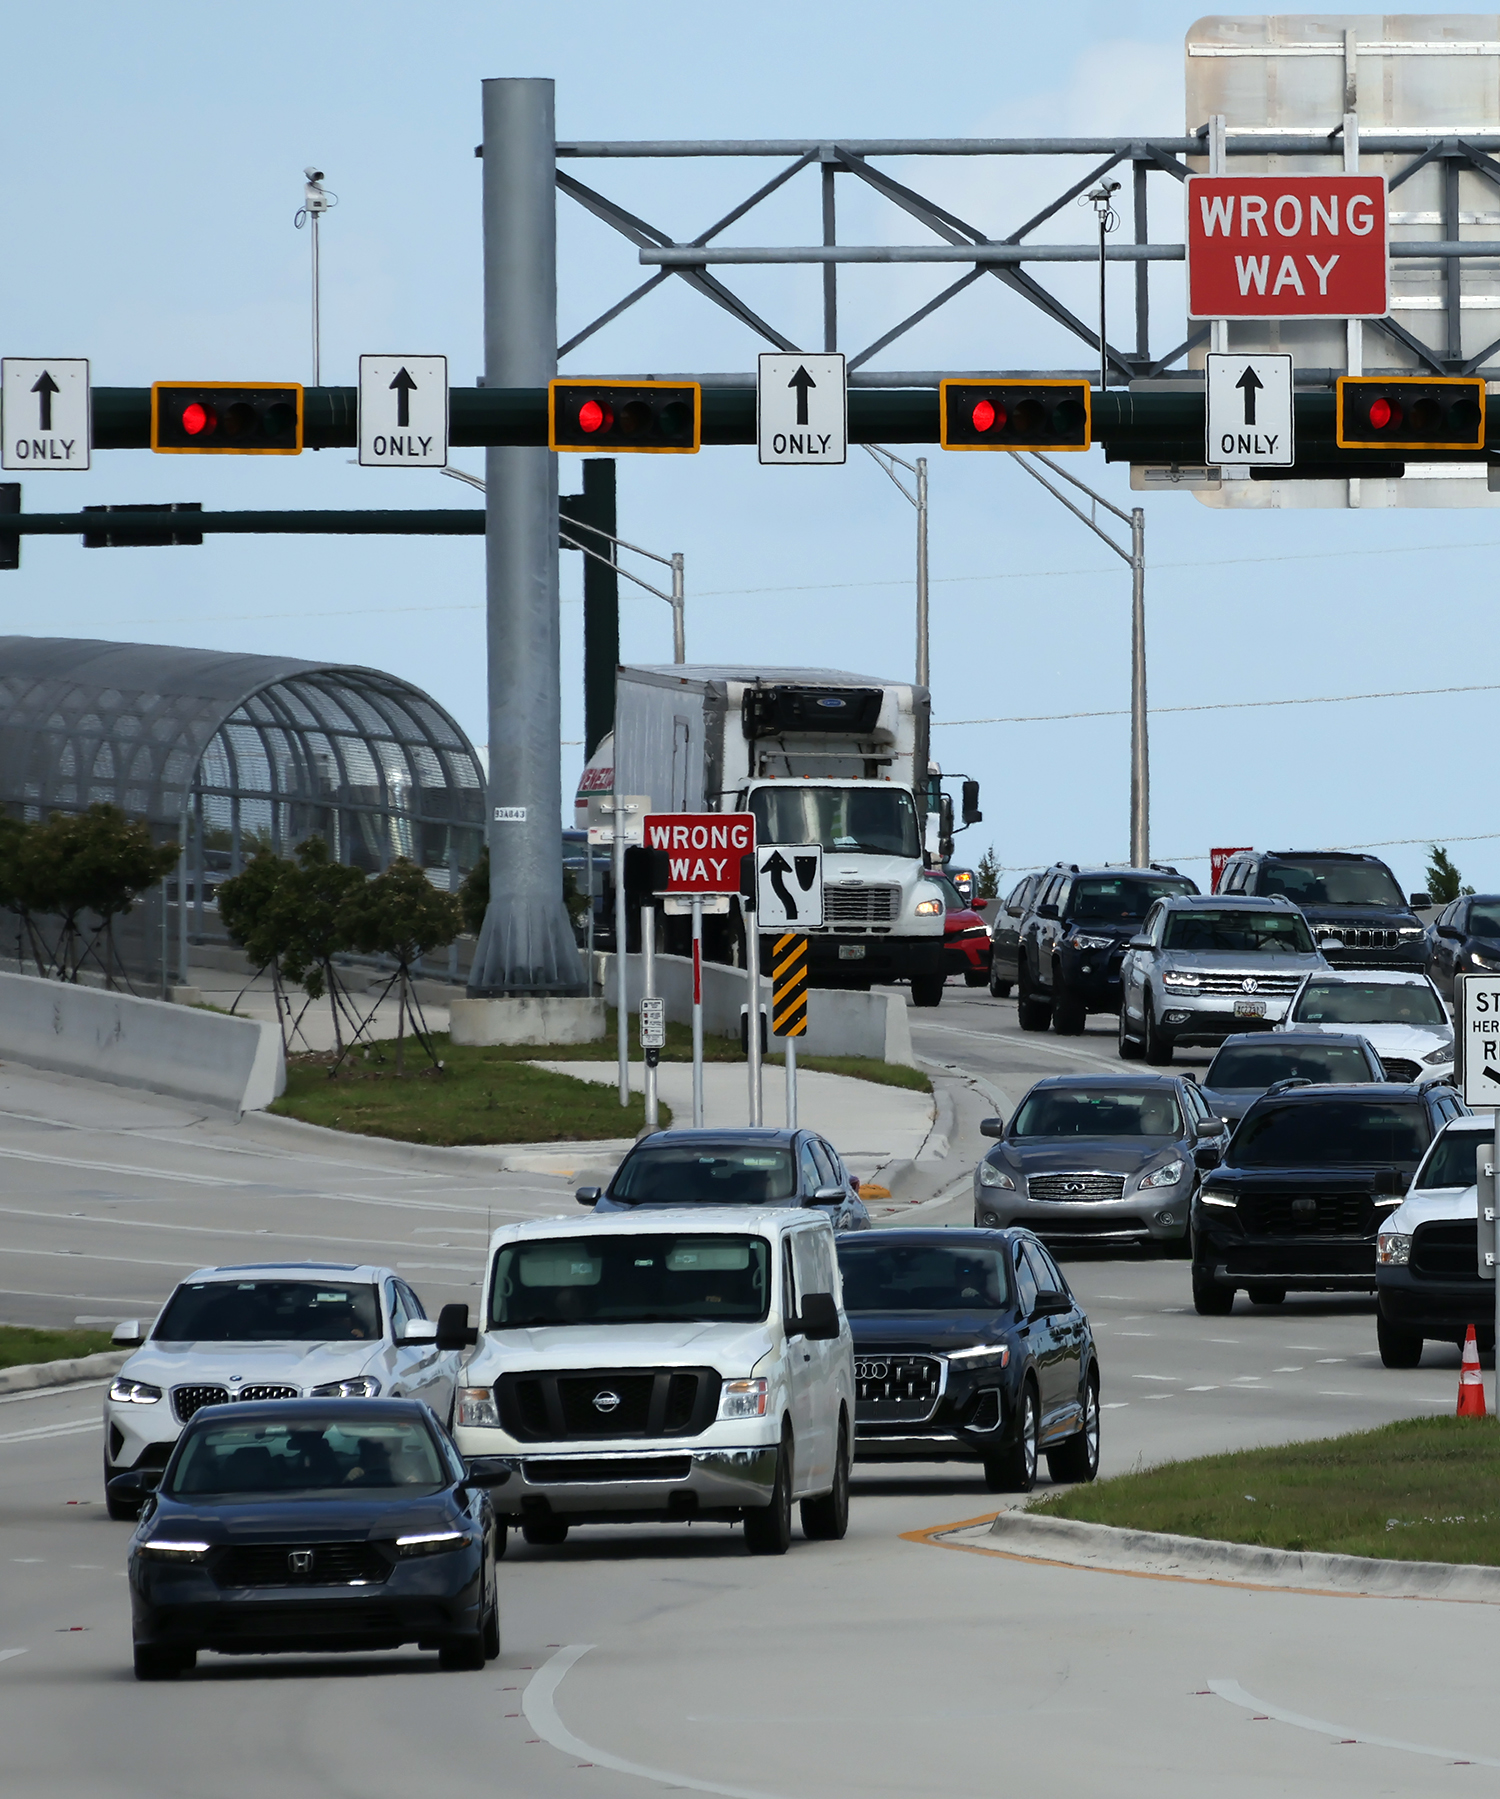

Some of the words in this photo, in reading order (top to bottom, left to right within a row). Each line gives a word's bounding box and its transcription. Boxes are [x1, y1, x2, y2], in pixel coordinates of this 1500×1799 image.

[1199, 194, 1374, 237] WRONG
[1234, 254, 1340, 296] WAY
[16, 439, 75, 460] ONLY
[373, 436, 432, 457] ONLY
[772, 433, 832, 455] ONLY
[1221, 433, 1279, 455] ONLY
[648, 825, 749, 850] WRONG
[669, 857, 728, 881] WAY
